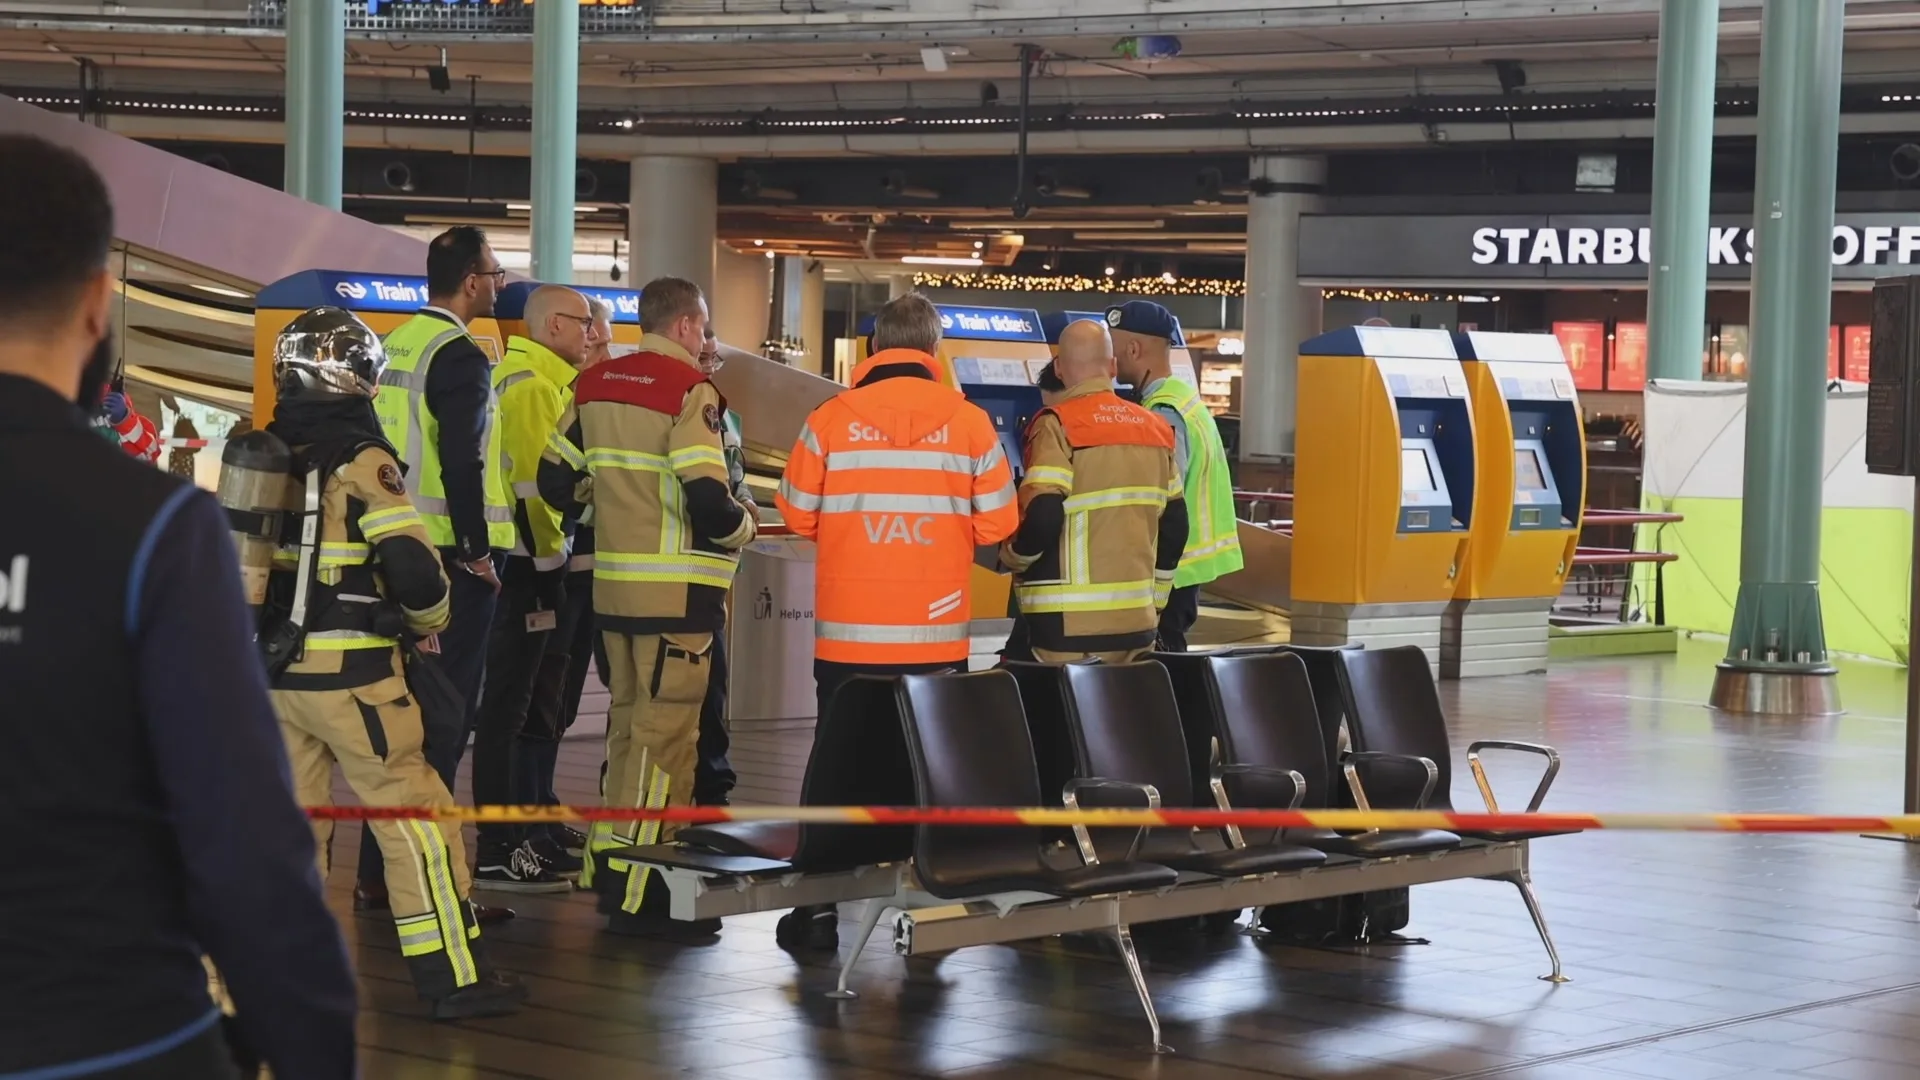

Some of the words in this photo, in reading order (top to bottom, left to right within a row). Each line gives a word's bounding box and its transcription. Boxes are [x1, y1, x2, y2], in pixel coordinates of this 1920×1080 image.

[1472, 227, 1755, 264] STARBK
[1831, 225, 1920, 265] OFF
[371, 281, 418, 302] Train
[955, 313, 990, 331] Train
[990, 314, 1033, 333] tickets
[1093, 413, 1113, 424] Fire
[848, 421, 949, 445] Scol
[862, 514, 936, 546] VAC
[780, 608, 802, 621] Help
[803, 609, 814, 618] us
